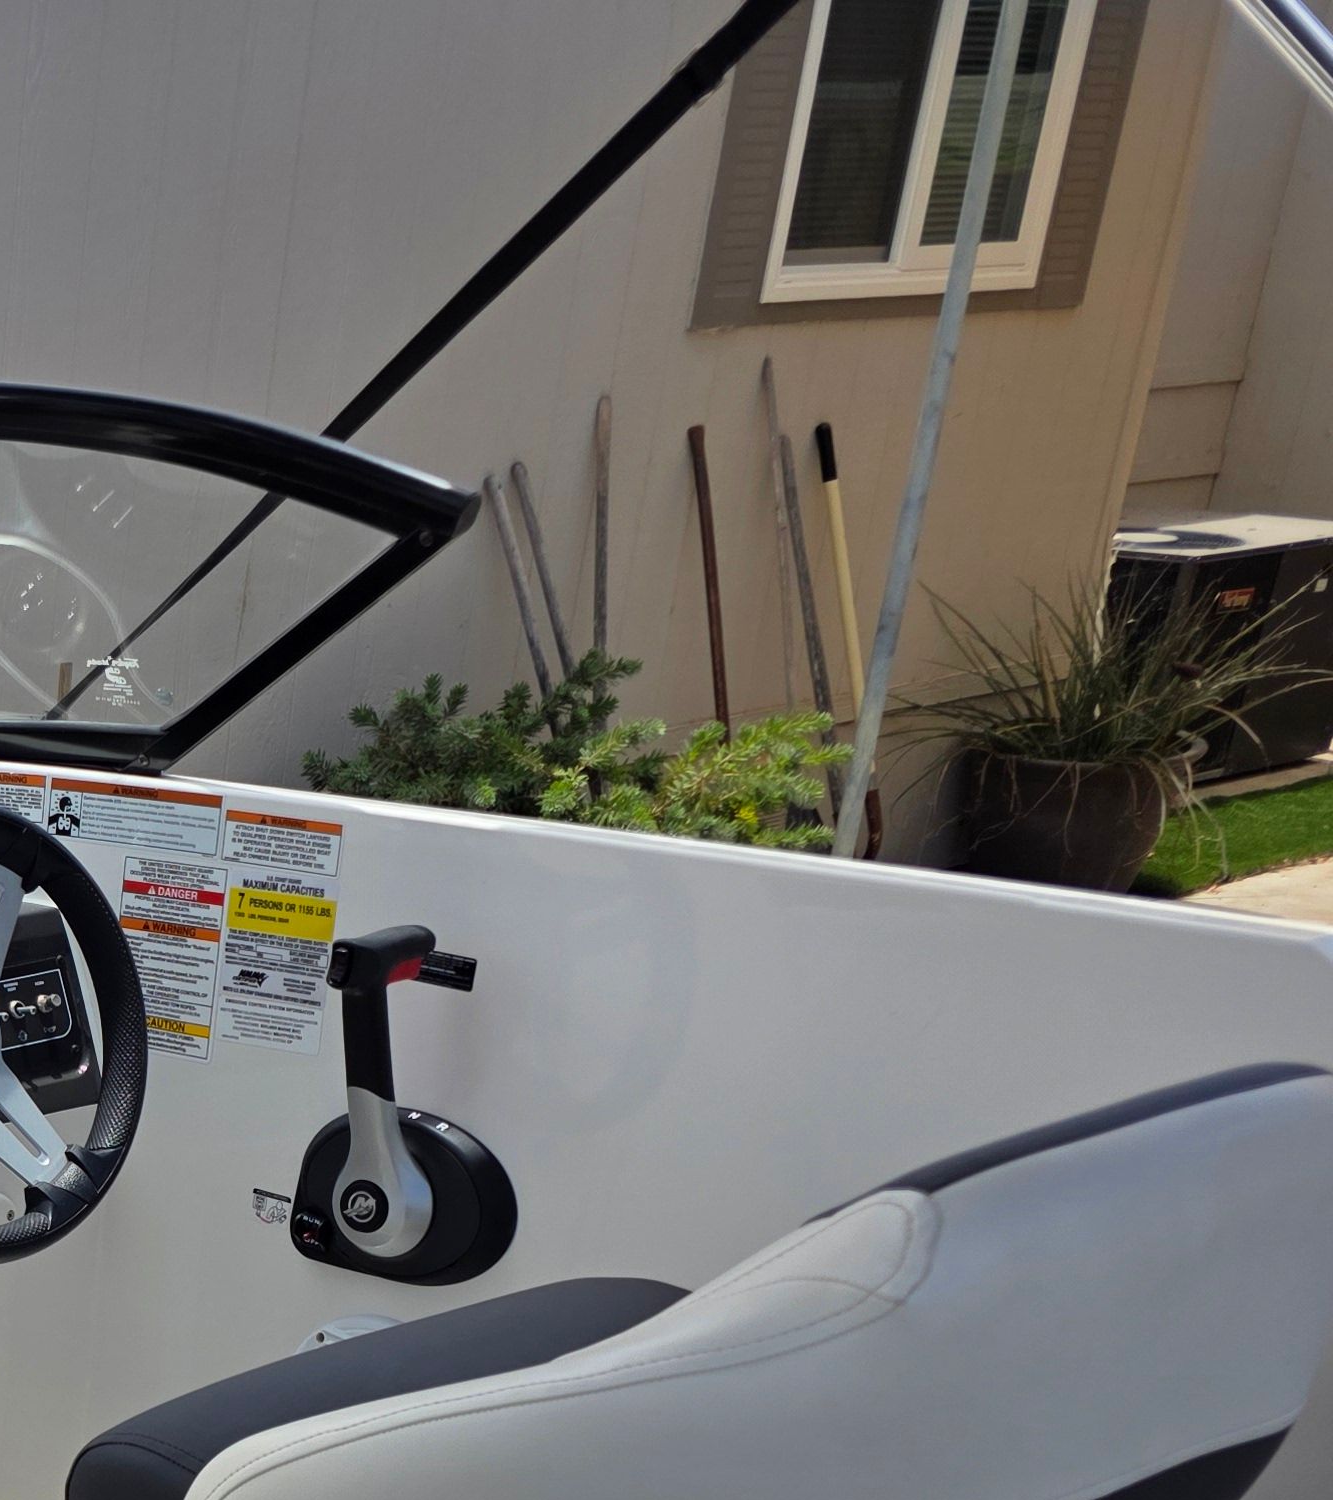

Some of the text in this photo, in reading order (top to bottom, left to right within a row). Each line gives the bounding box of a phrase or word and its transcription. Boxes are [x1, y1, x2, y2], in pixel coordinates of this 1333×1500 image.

[121, 787, 159, 798] WARNING
[158, 886, 198, 900] DANGER
[243, 879, 325, 898] MAXIMUM CAPACITIES
[238, 893, 245, 909] 7
[249, 898, 332, 918] PERSONS OR 1155 LBS.
[152, 922, 196, 937] WARNING
[147, 1016, 185, 1032] CAUTION
[436, 1122, 449, 1131] R
[303, 1215, 320, 1225] RUN
